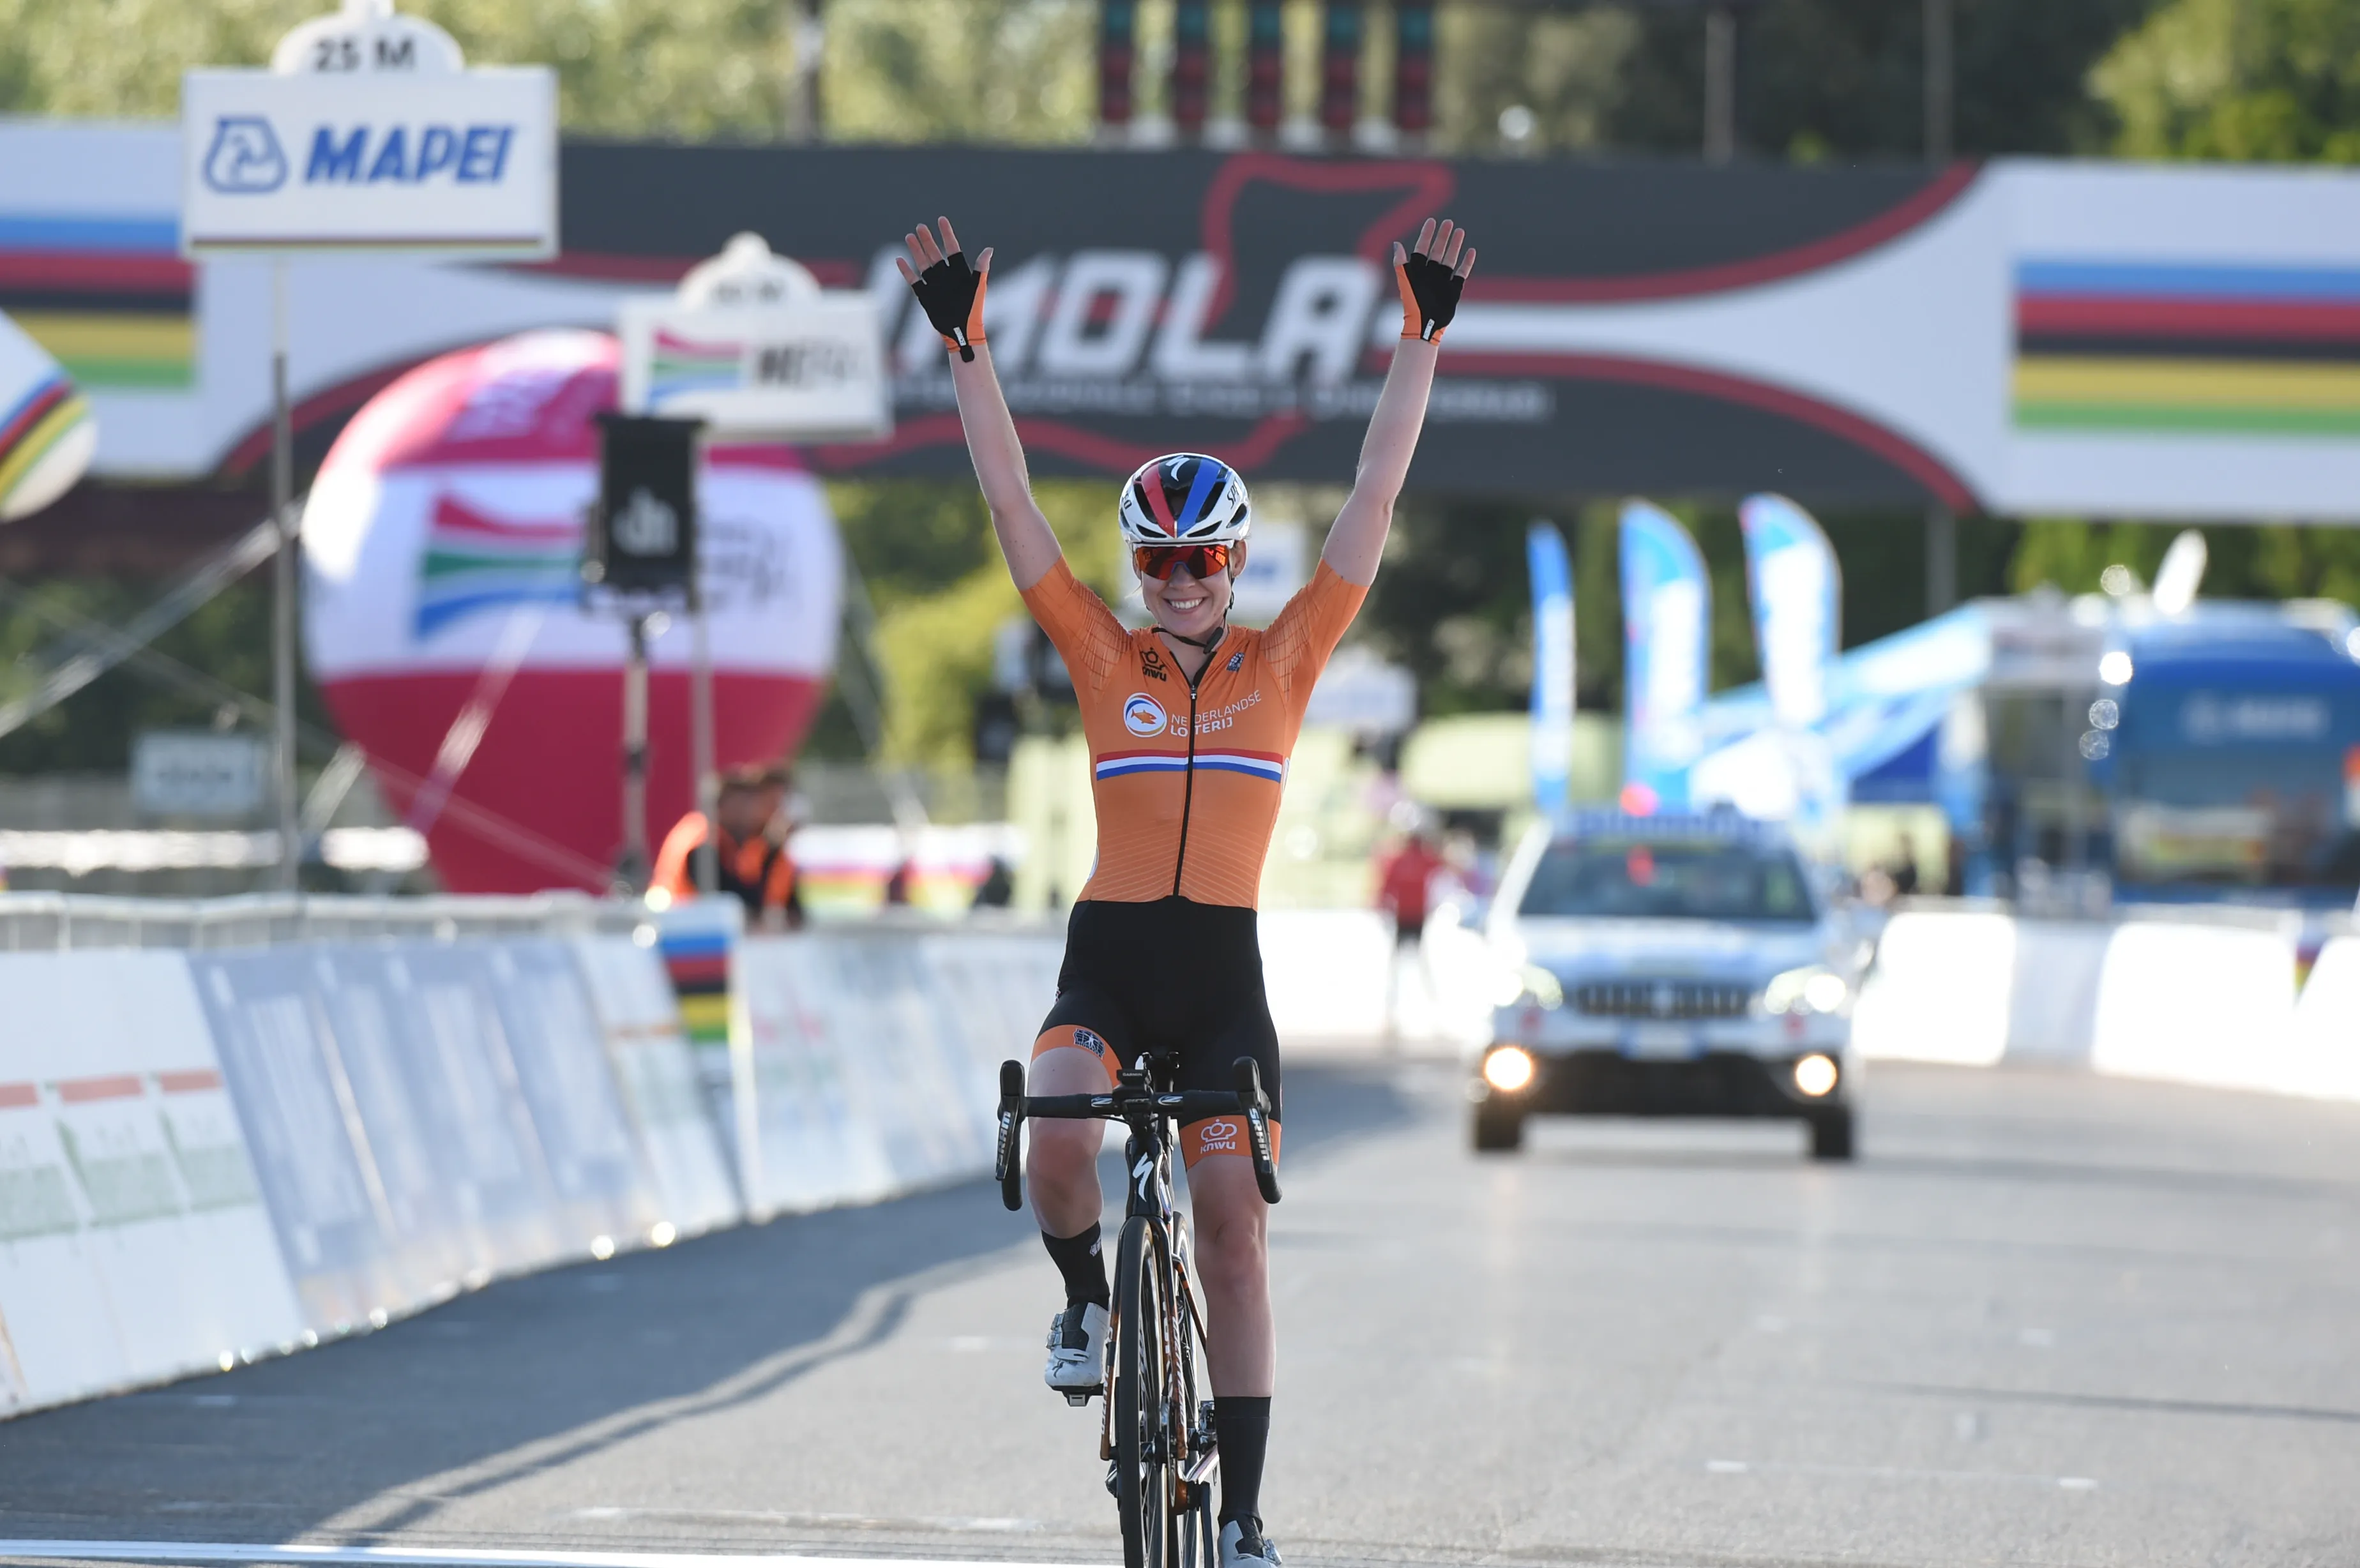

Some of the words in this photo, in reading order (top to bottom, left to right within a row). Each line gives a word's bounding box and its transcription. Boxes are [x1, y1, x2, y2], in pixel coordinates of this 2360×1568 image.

[315, 38, 360, 71] 25
[375, 37, 415, 68] M
[306, 126, 515, 183] MAPEI
[1172, 690, 1262, 726] NEDERLANDSE
[1170, 716, 1233, 737] LOTERIJ
